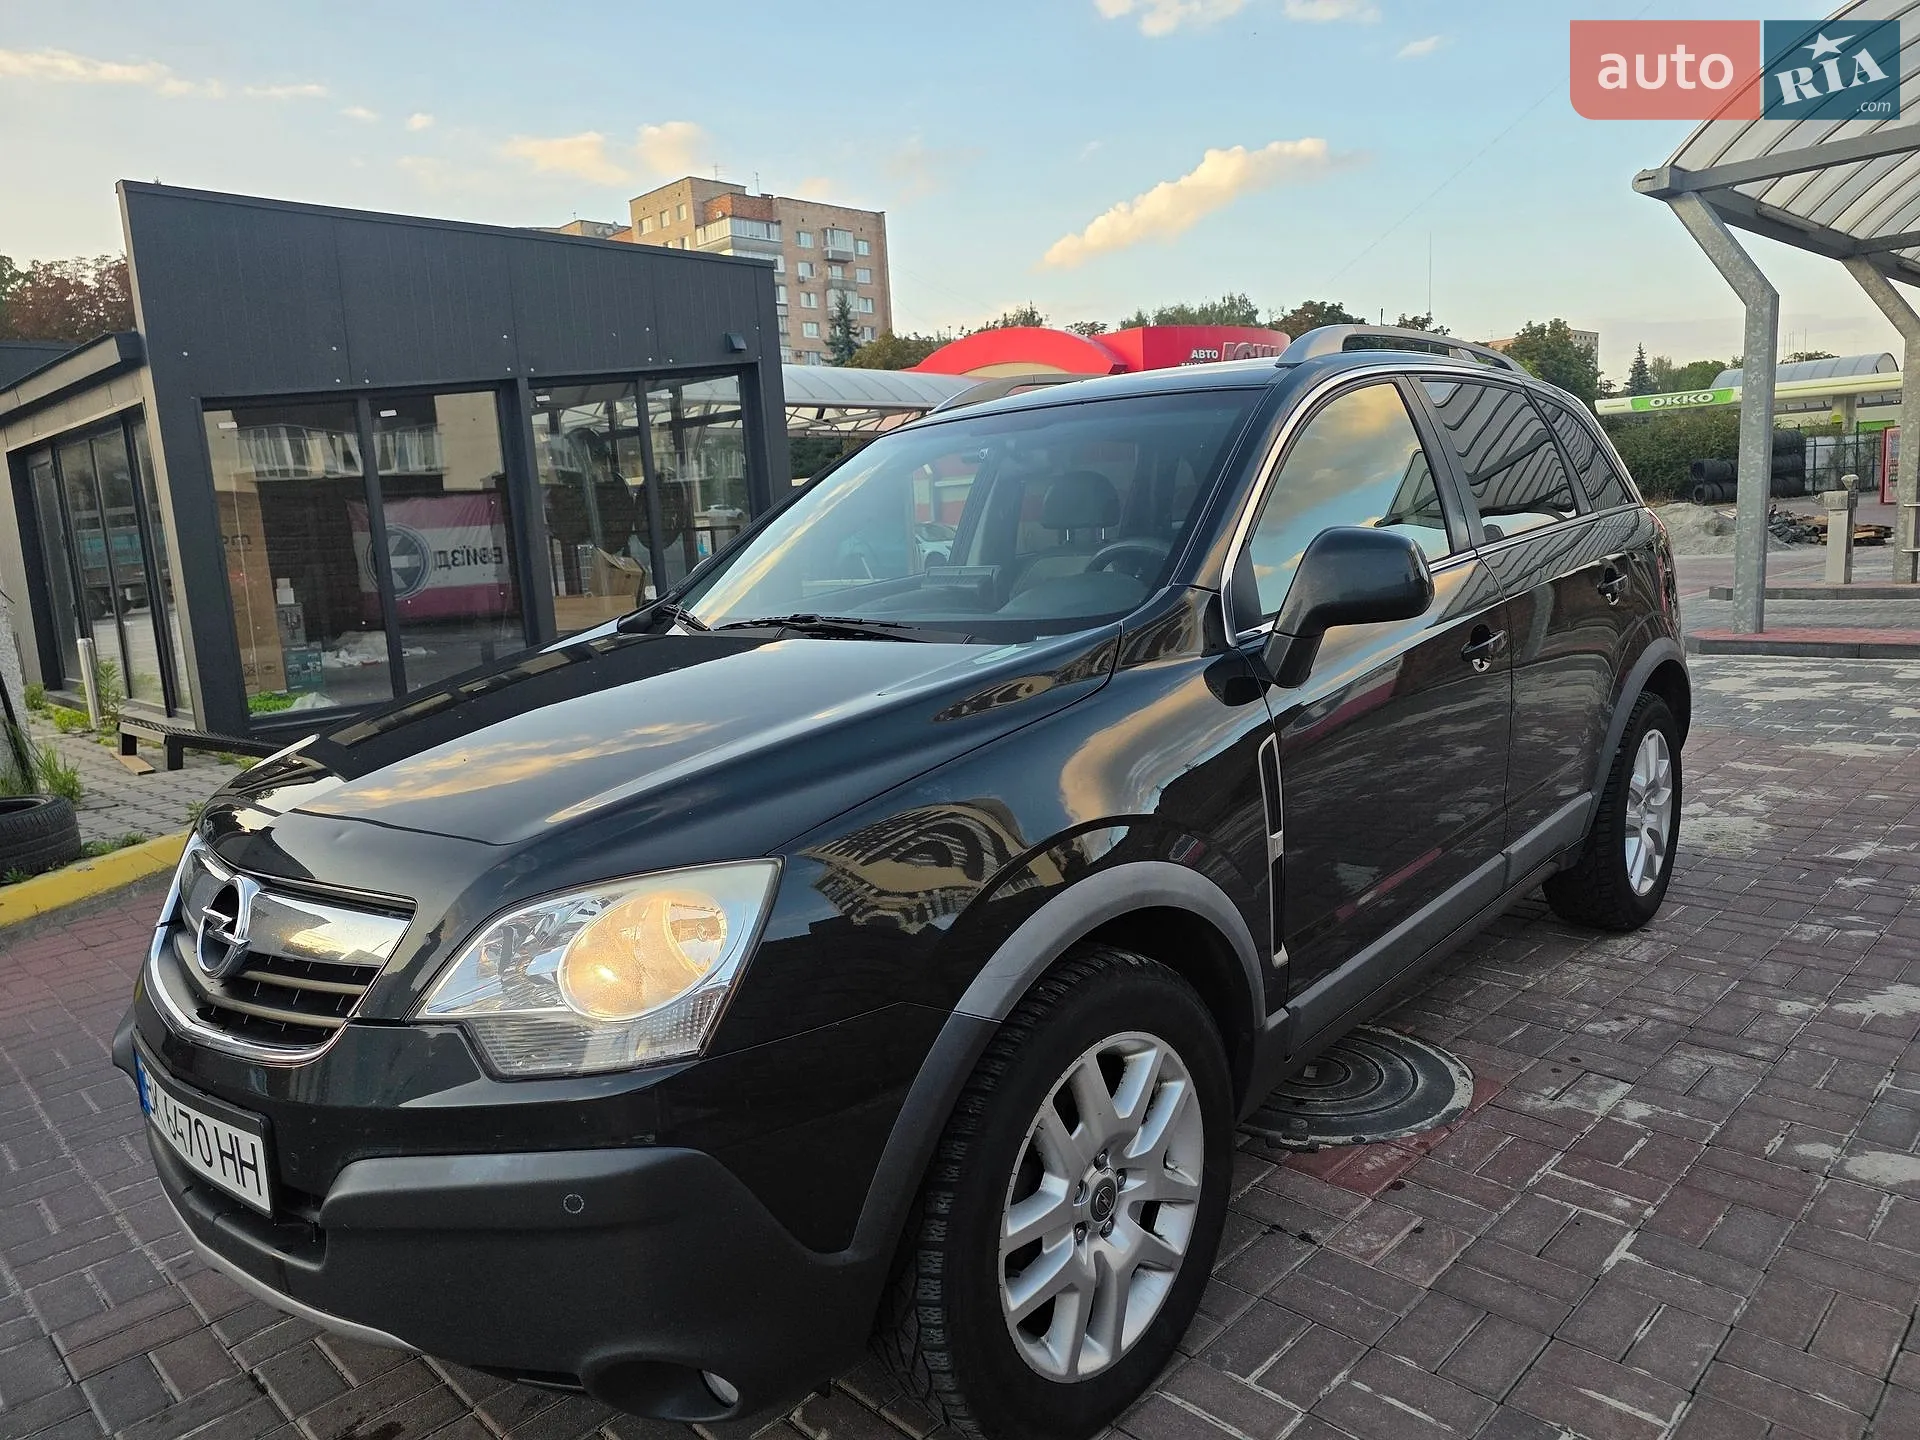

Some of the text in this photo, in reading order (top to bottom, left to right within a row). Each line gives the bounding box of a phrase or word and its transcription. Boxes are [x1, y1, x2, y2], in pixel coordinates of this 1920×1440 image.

[1191, 349, 1219, 359] АВТО
[1649, 391, 1714, 408] OKKO
[213, 1126, 262, 1197] HH
